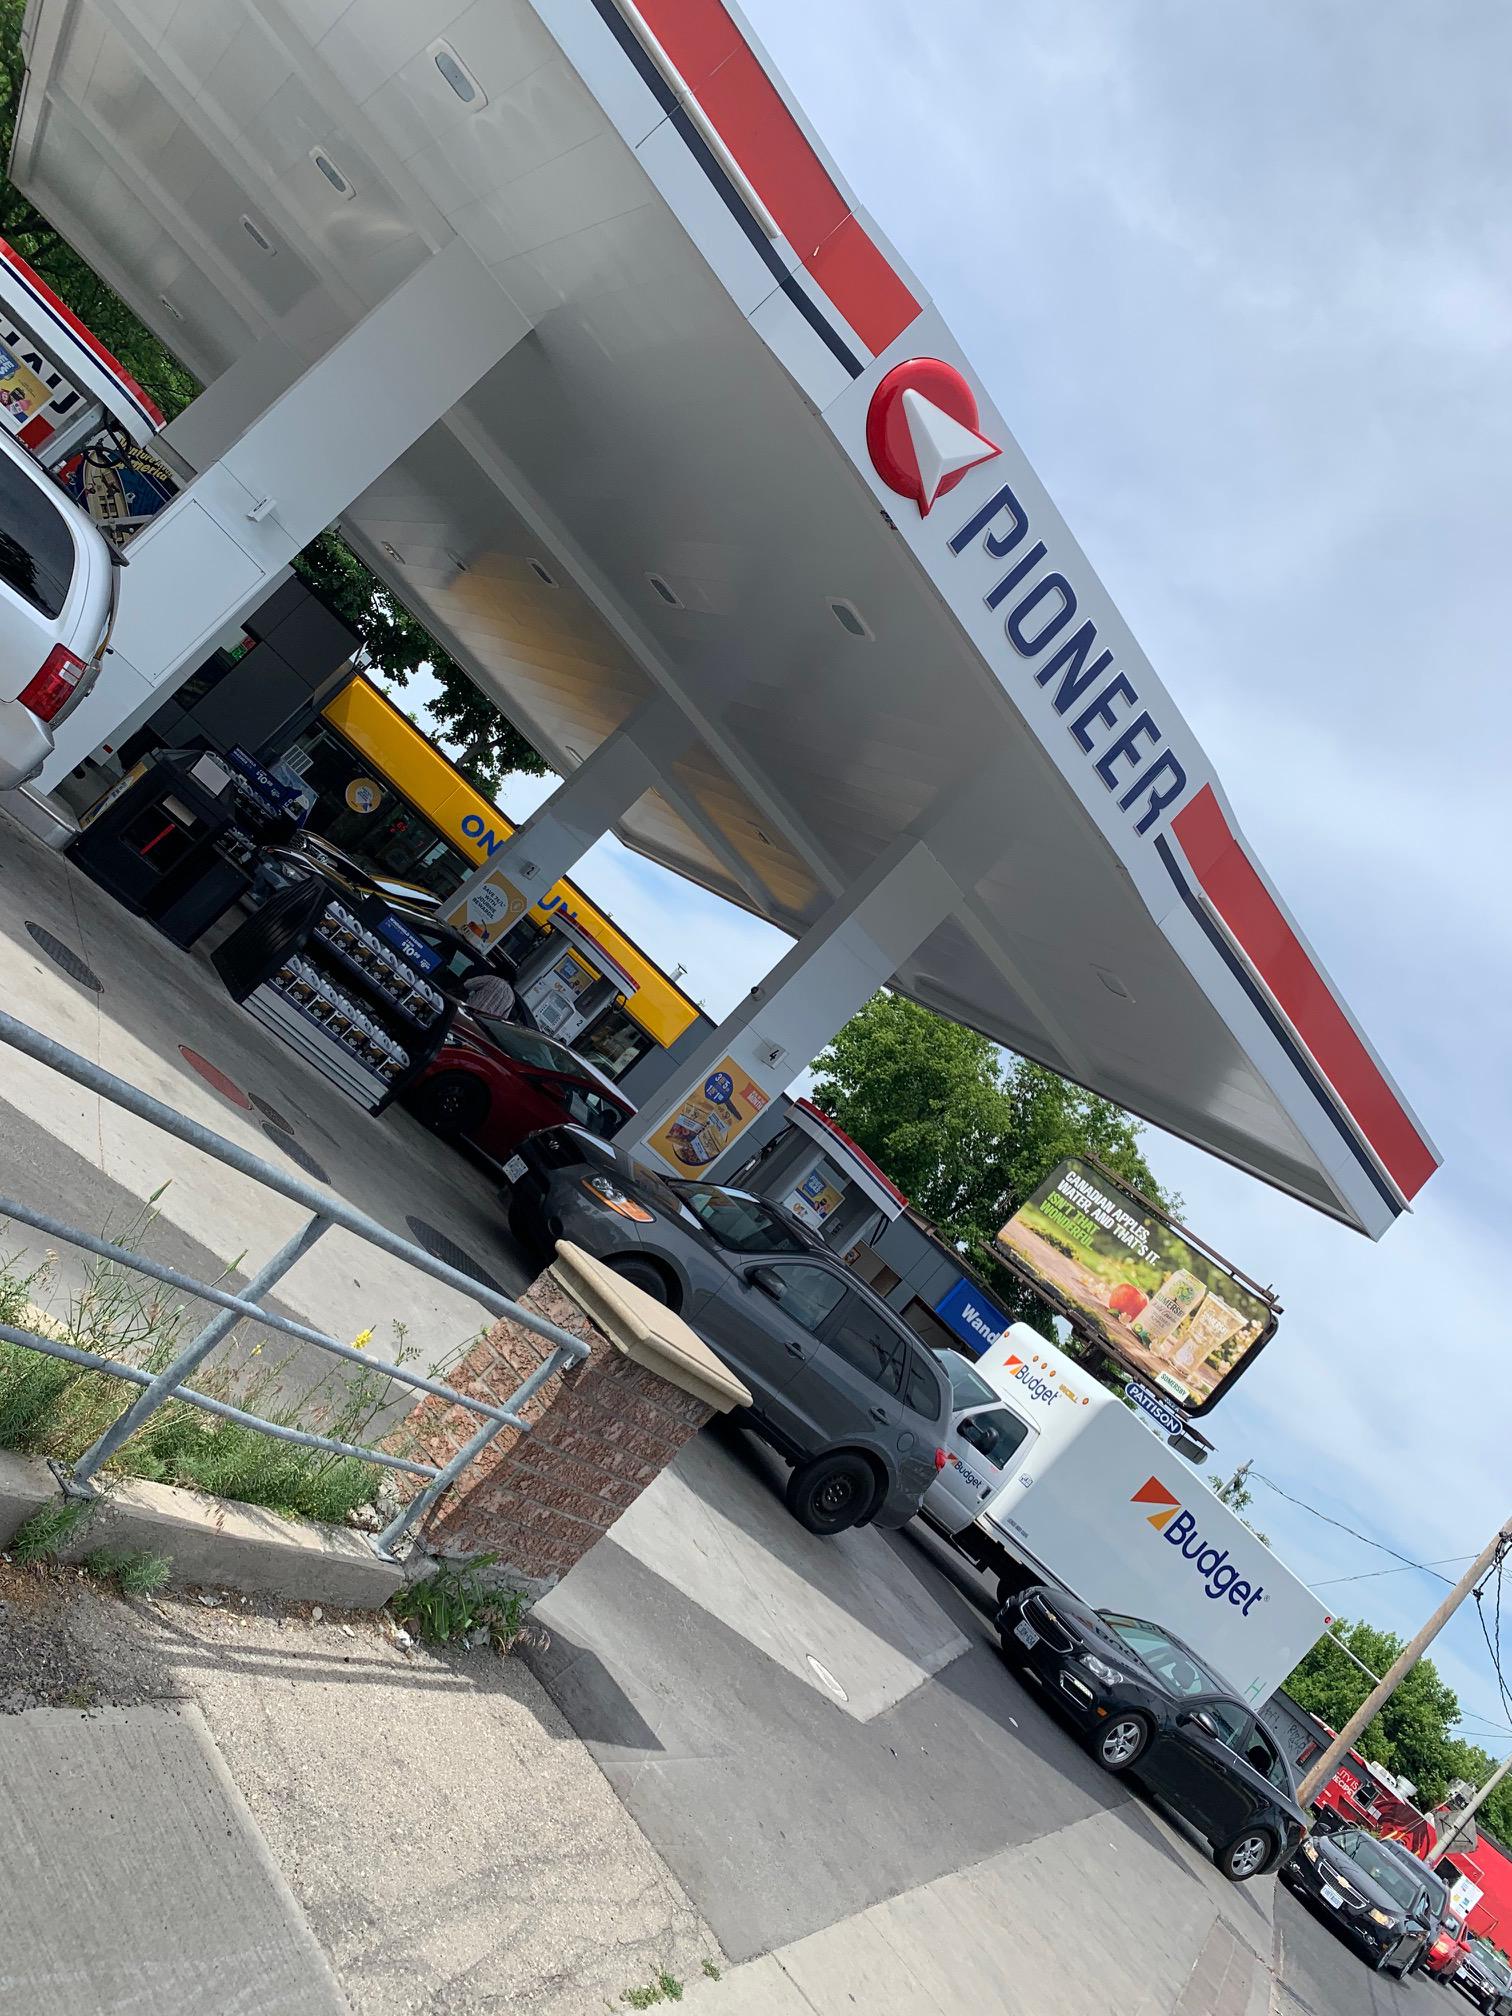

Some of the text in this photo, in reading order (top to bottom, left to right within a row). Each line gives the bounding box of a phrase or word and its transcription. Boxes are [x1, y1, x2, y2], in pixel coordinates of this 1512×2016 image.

[946, 482, 1188, 837] PIONEER
[461, 814, 505, 856] ON
[526, 865, 535, 875] 2
[481, 884, 495, 898] SAVE
[483, 893, 497, 907] WITH
[575, 1018, 584, 1027] 2
[769, 1049, 779, 1061] 4
[713, 1072, 723, 1082] 3
[1046, 1190, 1101, 1236] ISN'T THAT
[1055, 1179, 1160, 1266] WATER, AND THAT'S IT.
[1063, 1169, 1151, 1245] CANADIAN APPLES,
[1038, 1199, 1096, 1251] WONDERFUL.
[1016, 1365, 1059, 1405] Budget
[1159, 1372, 1187, 1397] SOMERSBY
[1128, 1385, 1179, 1432] PATTISON
[952, 1460, 982, 1489] Budget
[1163, 1509, 1264, 1616] Budget
[1349, 1780, 1359, 1790] IS
